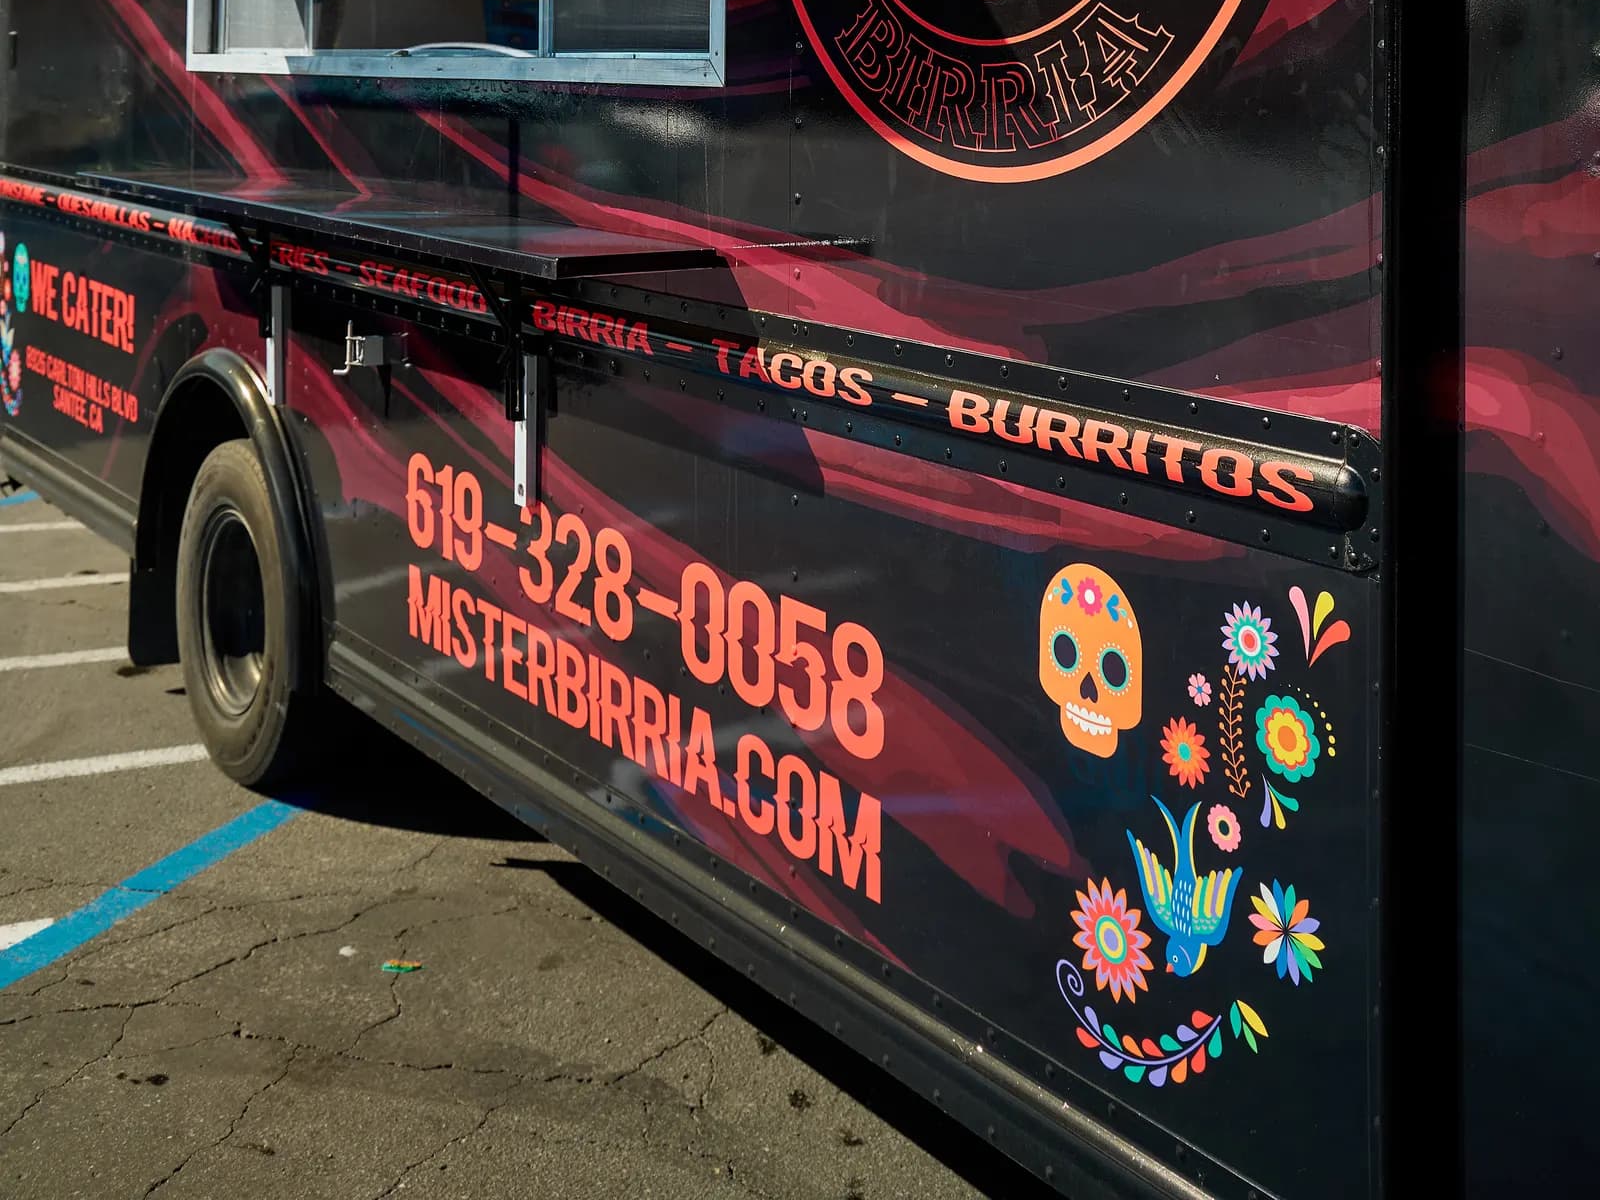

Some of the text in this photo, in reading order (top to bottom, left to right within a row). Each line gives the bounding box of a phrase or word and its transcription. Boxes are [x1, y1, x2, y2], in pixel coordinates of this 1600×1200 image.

[31, 259, 136, 354] WE CATER!
[57, 192, 151, 232] QUESADILLAS
[168, 218, 241, 254] NACHOS
[532, 300, 654, 356] BIRRIA
[711, 338, 874, 407] TACOS
[944, 389, 1316, 512] BURRITOS
[111, 385, 138, 423] BLVD
[89, 403, 104, 434] CA
[406, 452, 886, 760] 619-328-0058
[406, 563, 883, 905] MISTERBIRRIA.COM
